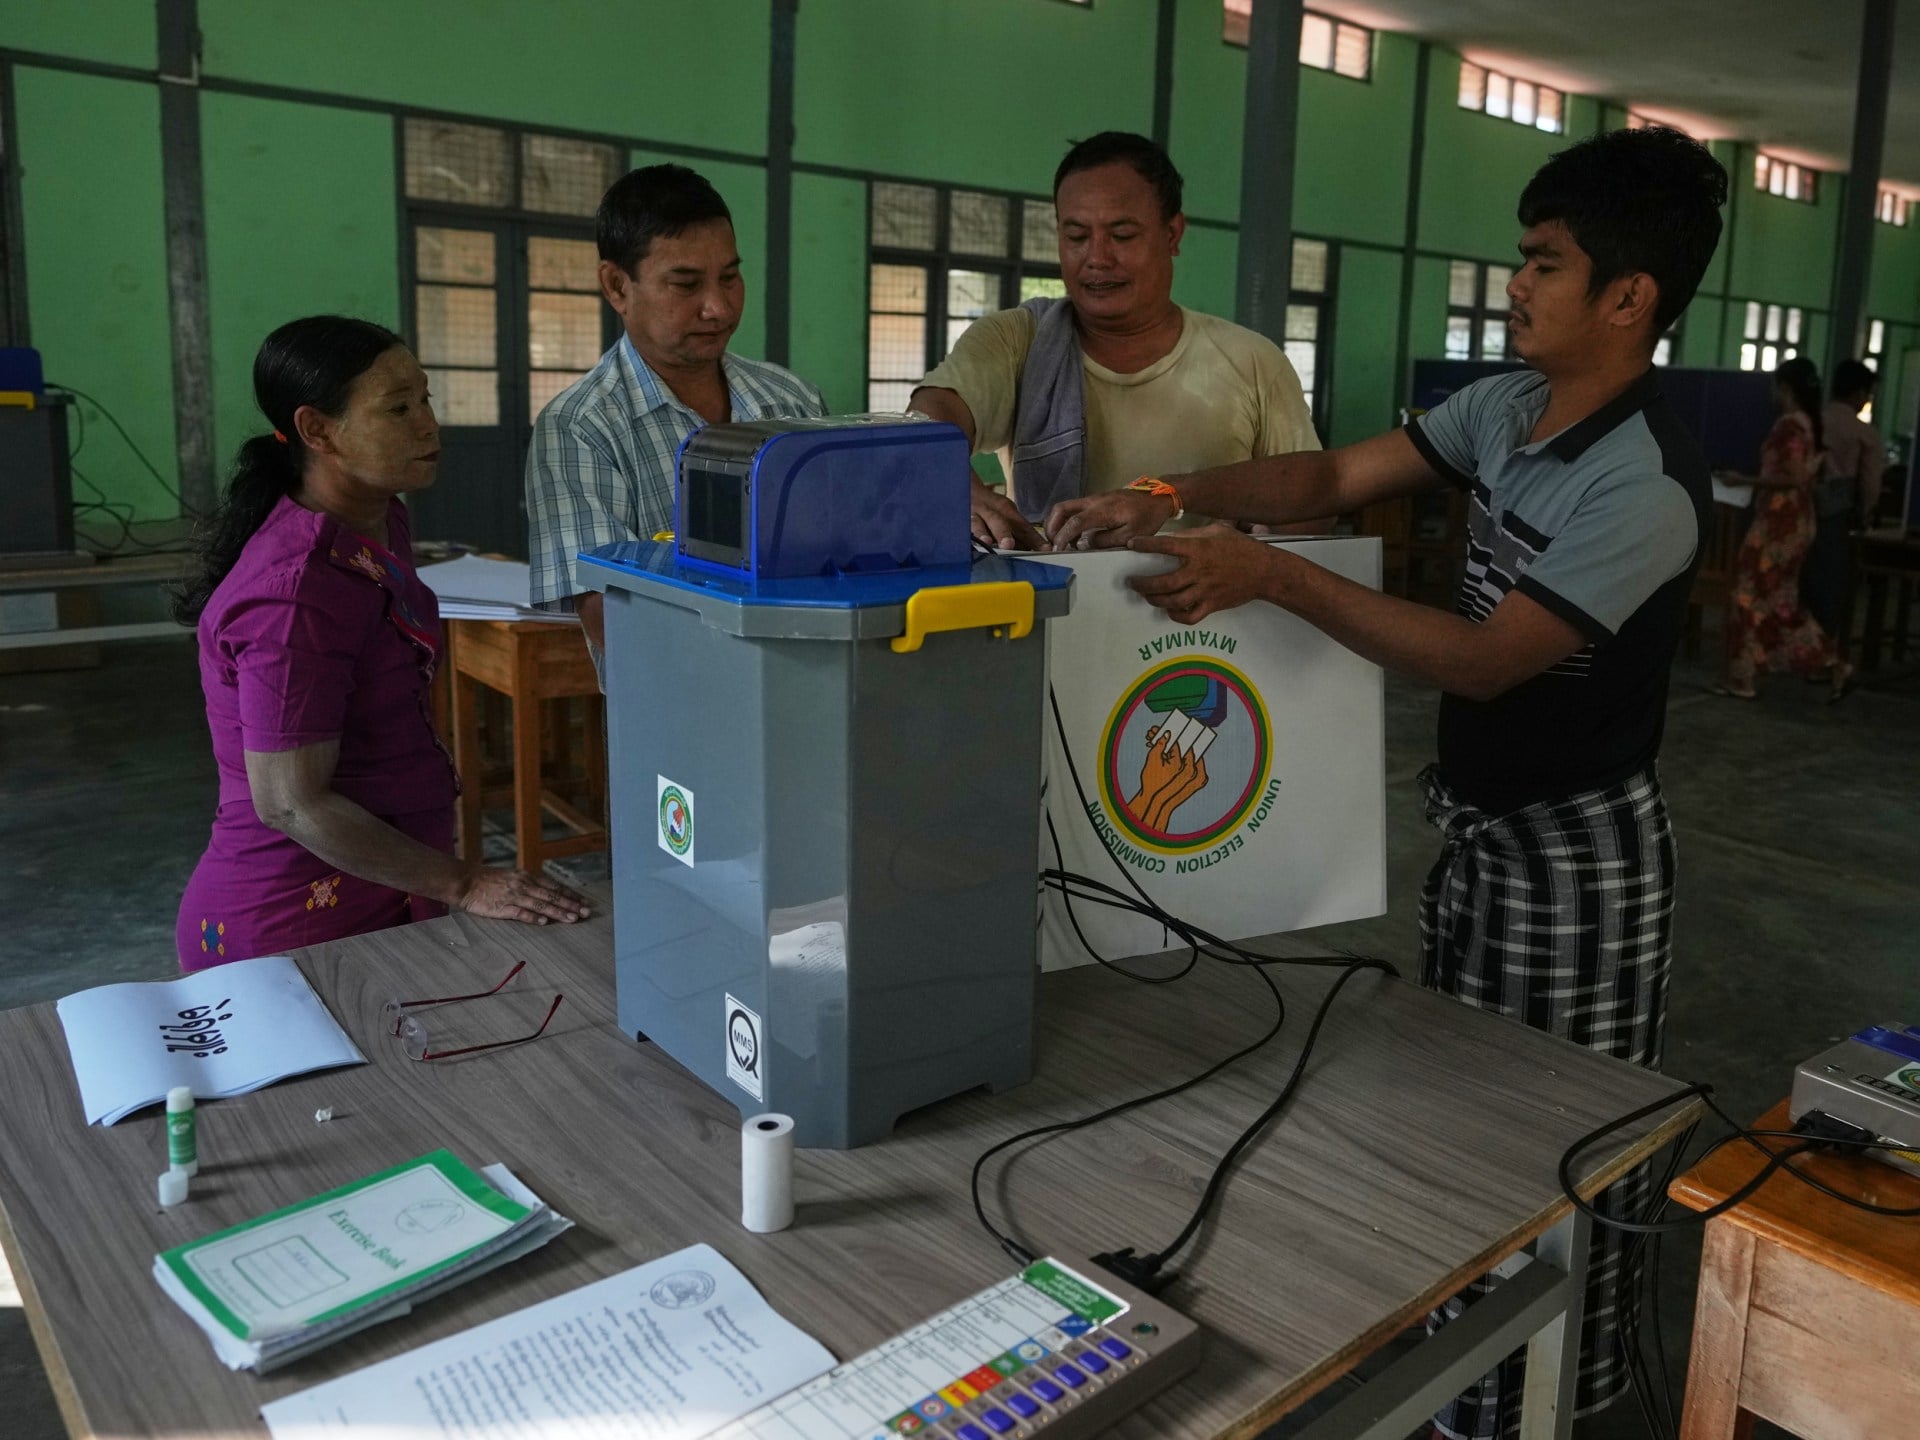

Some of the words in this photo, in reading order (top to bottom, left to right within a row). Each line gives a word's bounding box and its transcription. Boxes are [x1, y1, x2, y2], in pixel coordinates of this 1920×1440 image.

[1138, 630, 1237, 661] MYANMAR
[1247, 778, 1282, 833] UNION
[1088, 800, 1166, 873] COMMISSION
[1176, 834, 1244, 874] ELECTION
[733, 1029, 753, 1053] MMS
